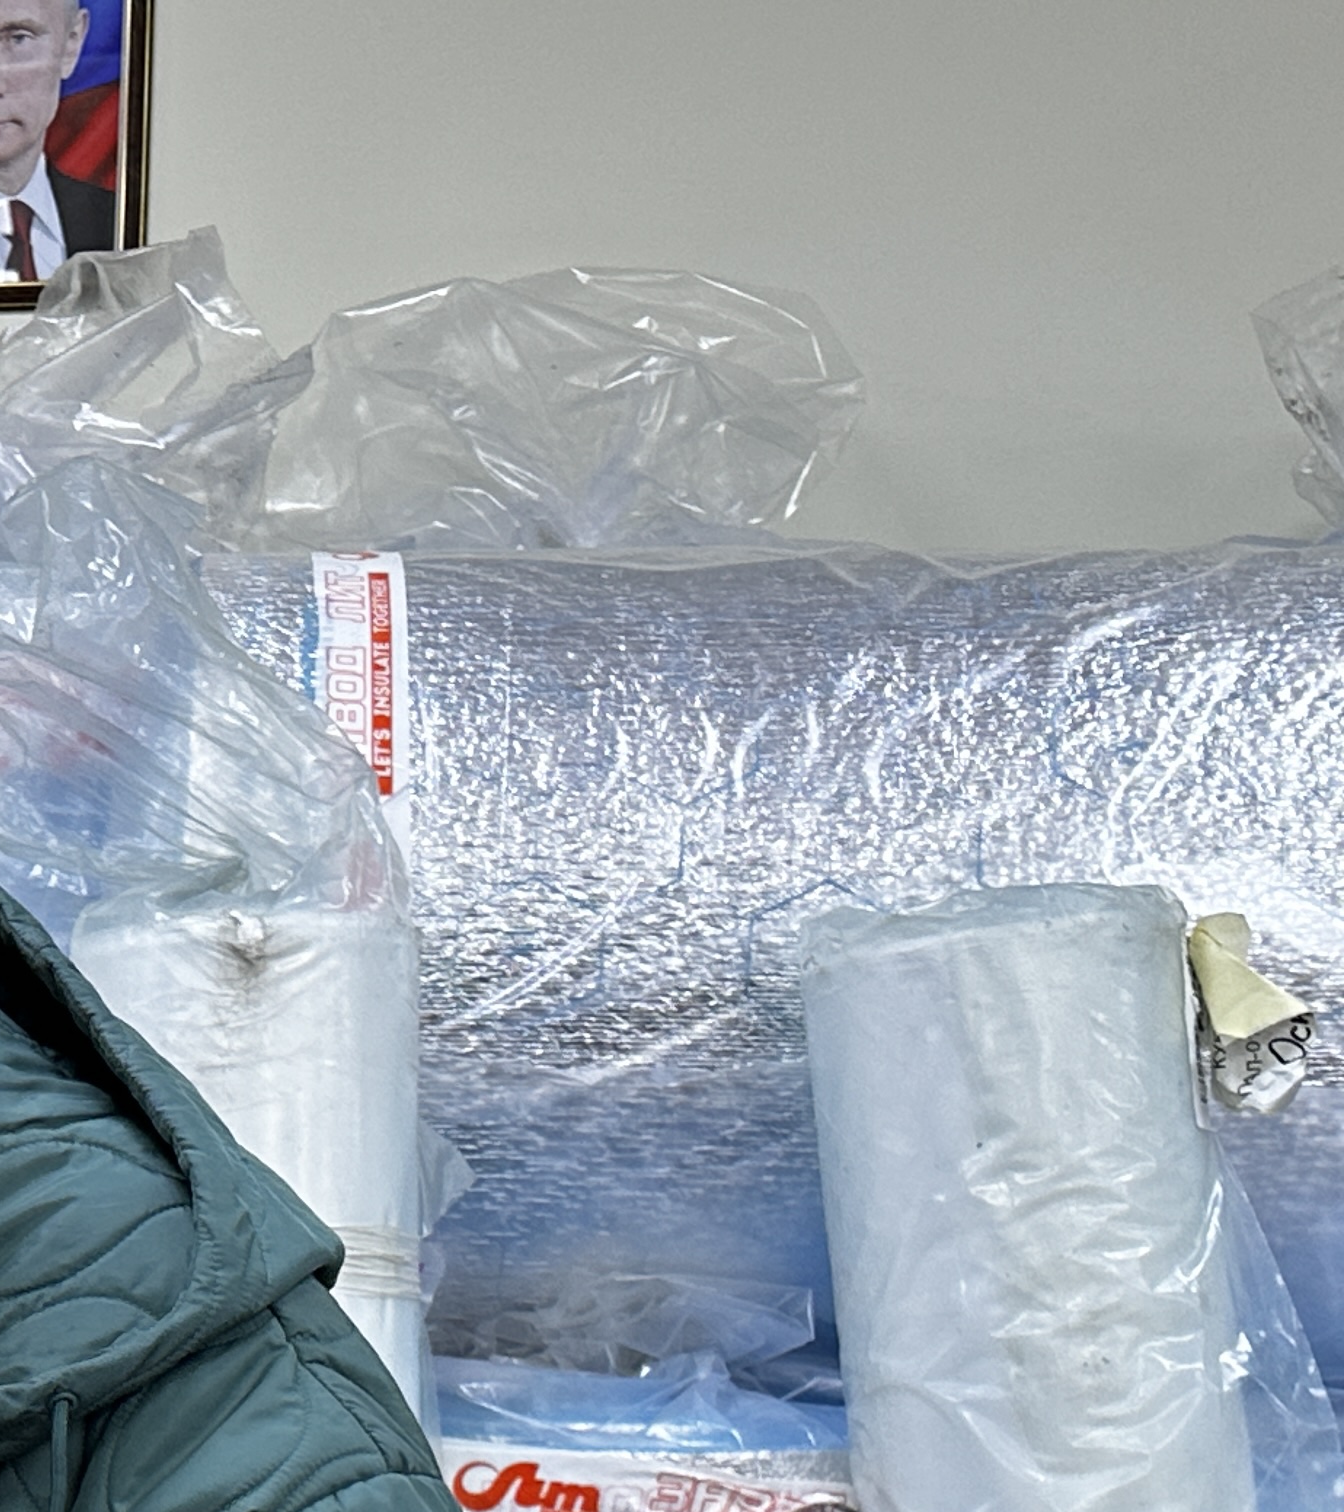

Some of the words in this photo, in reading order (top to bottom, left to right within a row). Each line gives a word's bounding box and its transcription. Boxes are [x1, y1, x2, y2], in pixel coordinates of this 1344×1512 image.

[371, 579, 389, 633] TOGETHER
[325, 646, 367, 745] ВОД
[372, 642, 391, 717] INSULATE
[373, 728, 392, 777] LET'S
